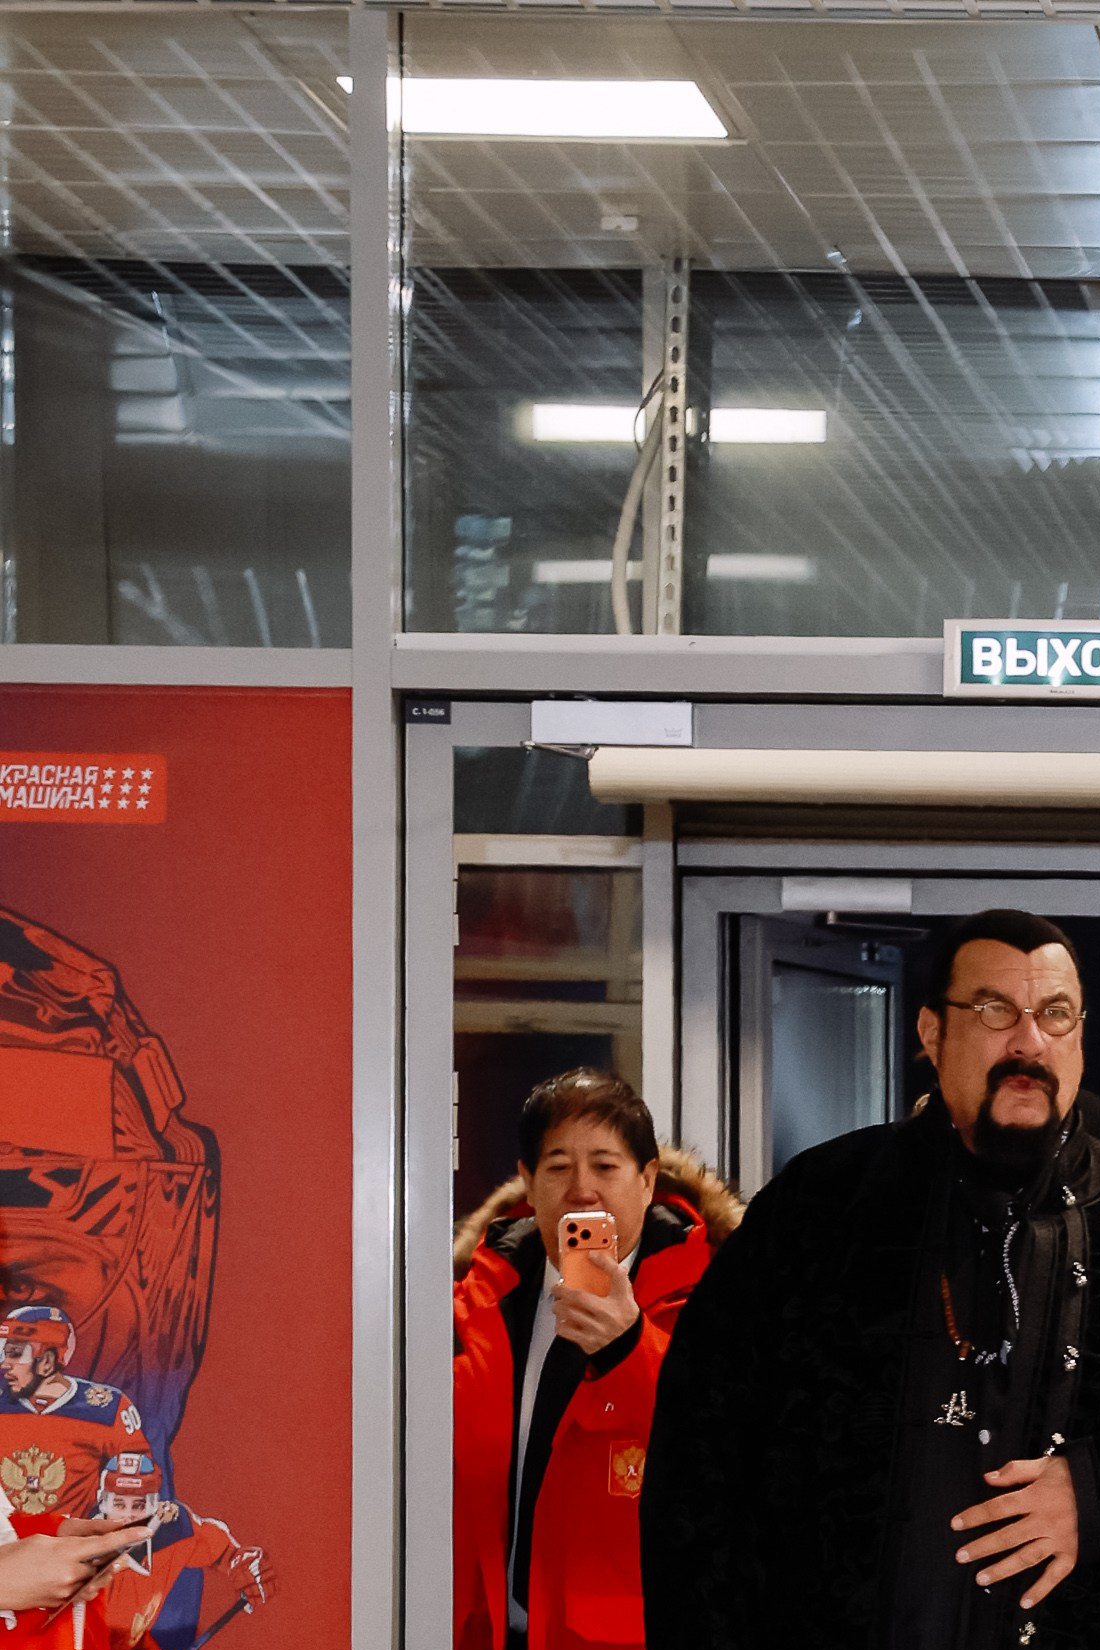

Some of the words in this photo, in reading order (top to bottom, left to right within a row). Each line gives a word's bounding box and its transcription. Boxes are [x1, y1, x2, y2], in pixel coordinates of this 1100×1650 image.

[0, 764, 99, 785] КРАСНАЯ
[0, 785, 95, 809] МАШИНА
[120, 1405, 141, 1434] 90
